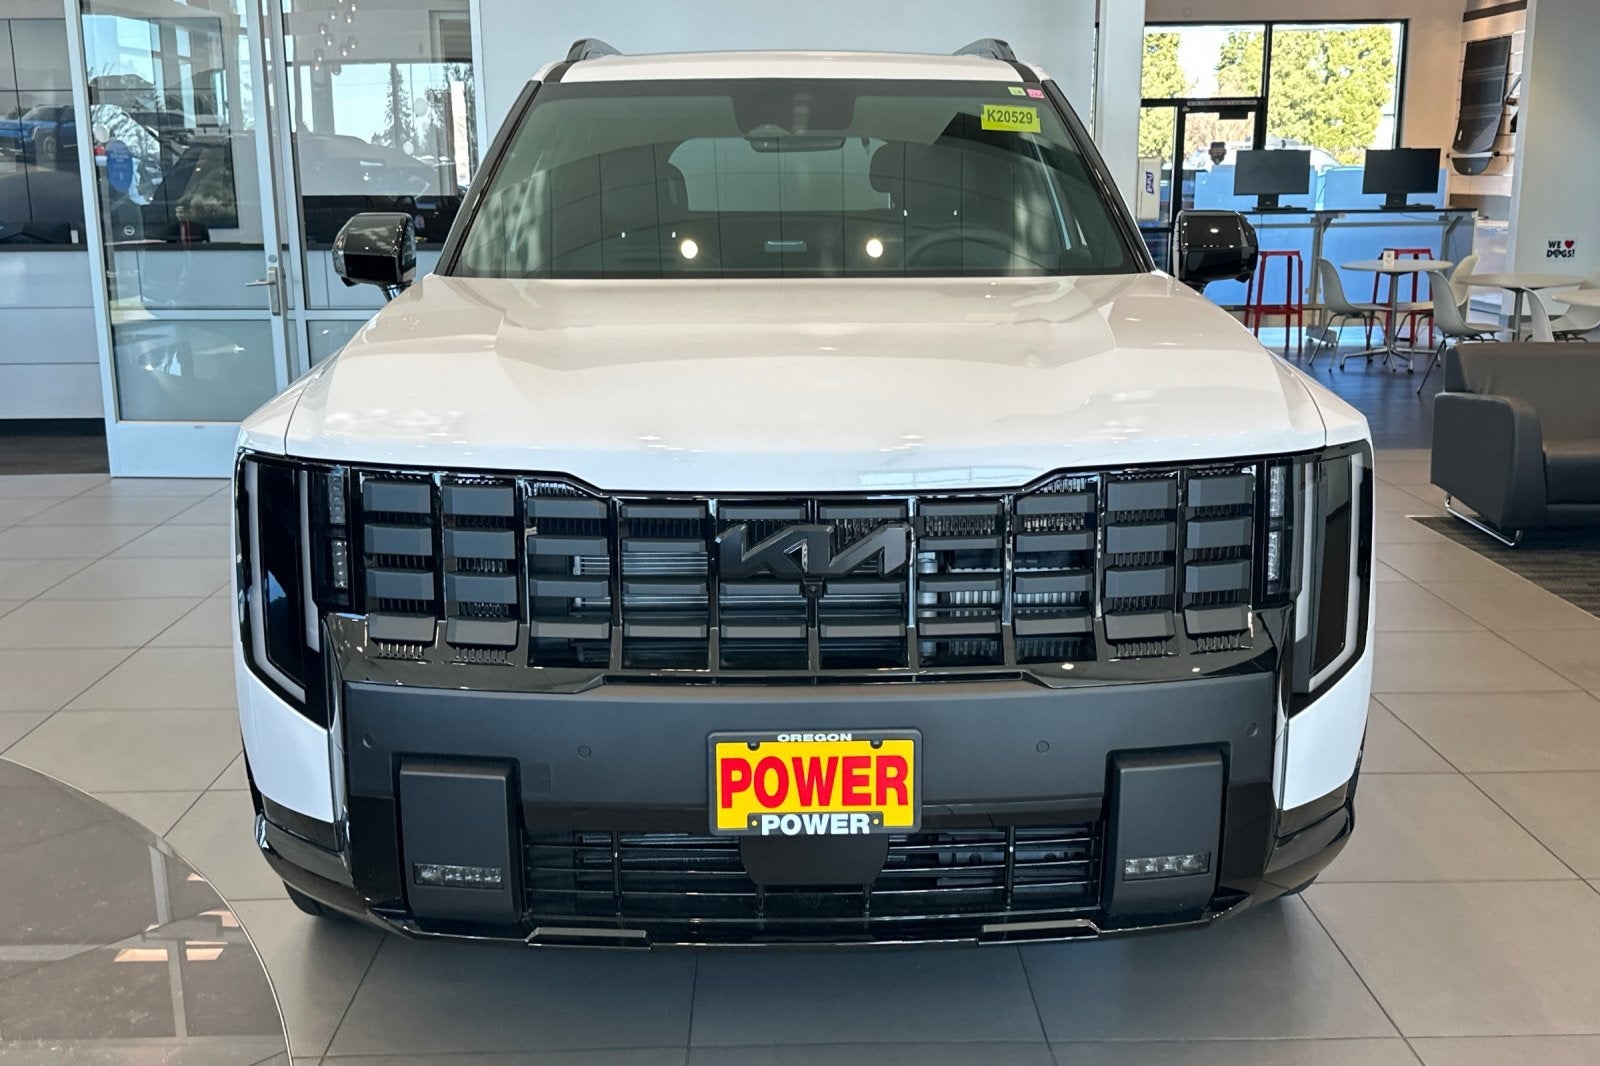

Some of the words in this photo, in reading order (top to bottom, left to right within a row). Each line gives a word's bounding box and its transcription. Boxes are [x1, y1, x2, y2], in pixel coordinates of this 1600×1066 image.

[987, 109, 1033, 124] K20529
[1548, 240, 1561, 249] WE
[1546, 249, 1575, 258] DOGS!
[715, 523, 910, 577] KIA
[777, 733, 852, 742] OREGON
[720, 755, 909, 809] POWER
[761, 813, 870, 836] POWER
